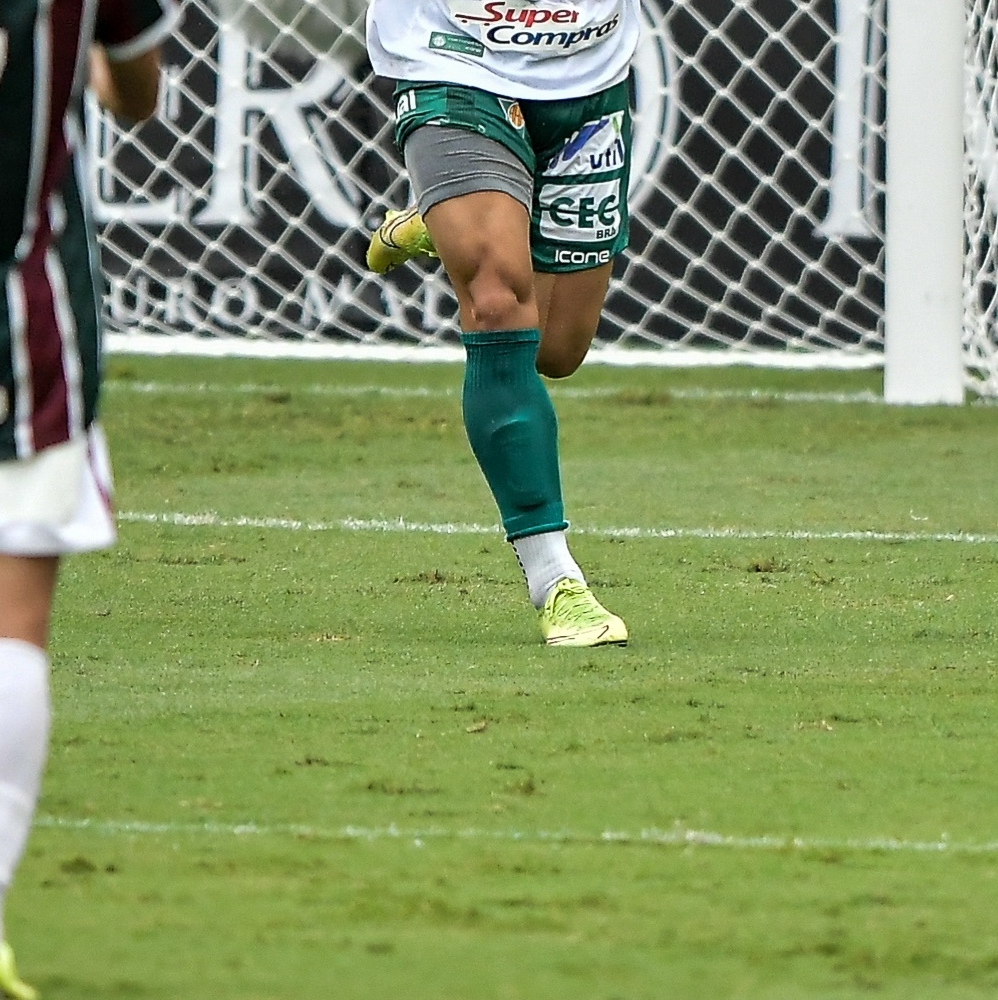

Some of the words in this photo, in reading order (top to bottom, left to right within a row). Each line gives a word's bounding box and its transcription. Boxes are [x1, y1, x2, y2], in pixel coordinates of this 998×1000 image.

[483, 1, 580, 27] Super
[487, 13, 620, 49] Compras
[549, 193, 617, 229] CEC
